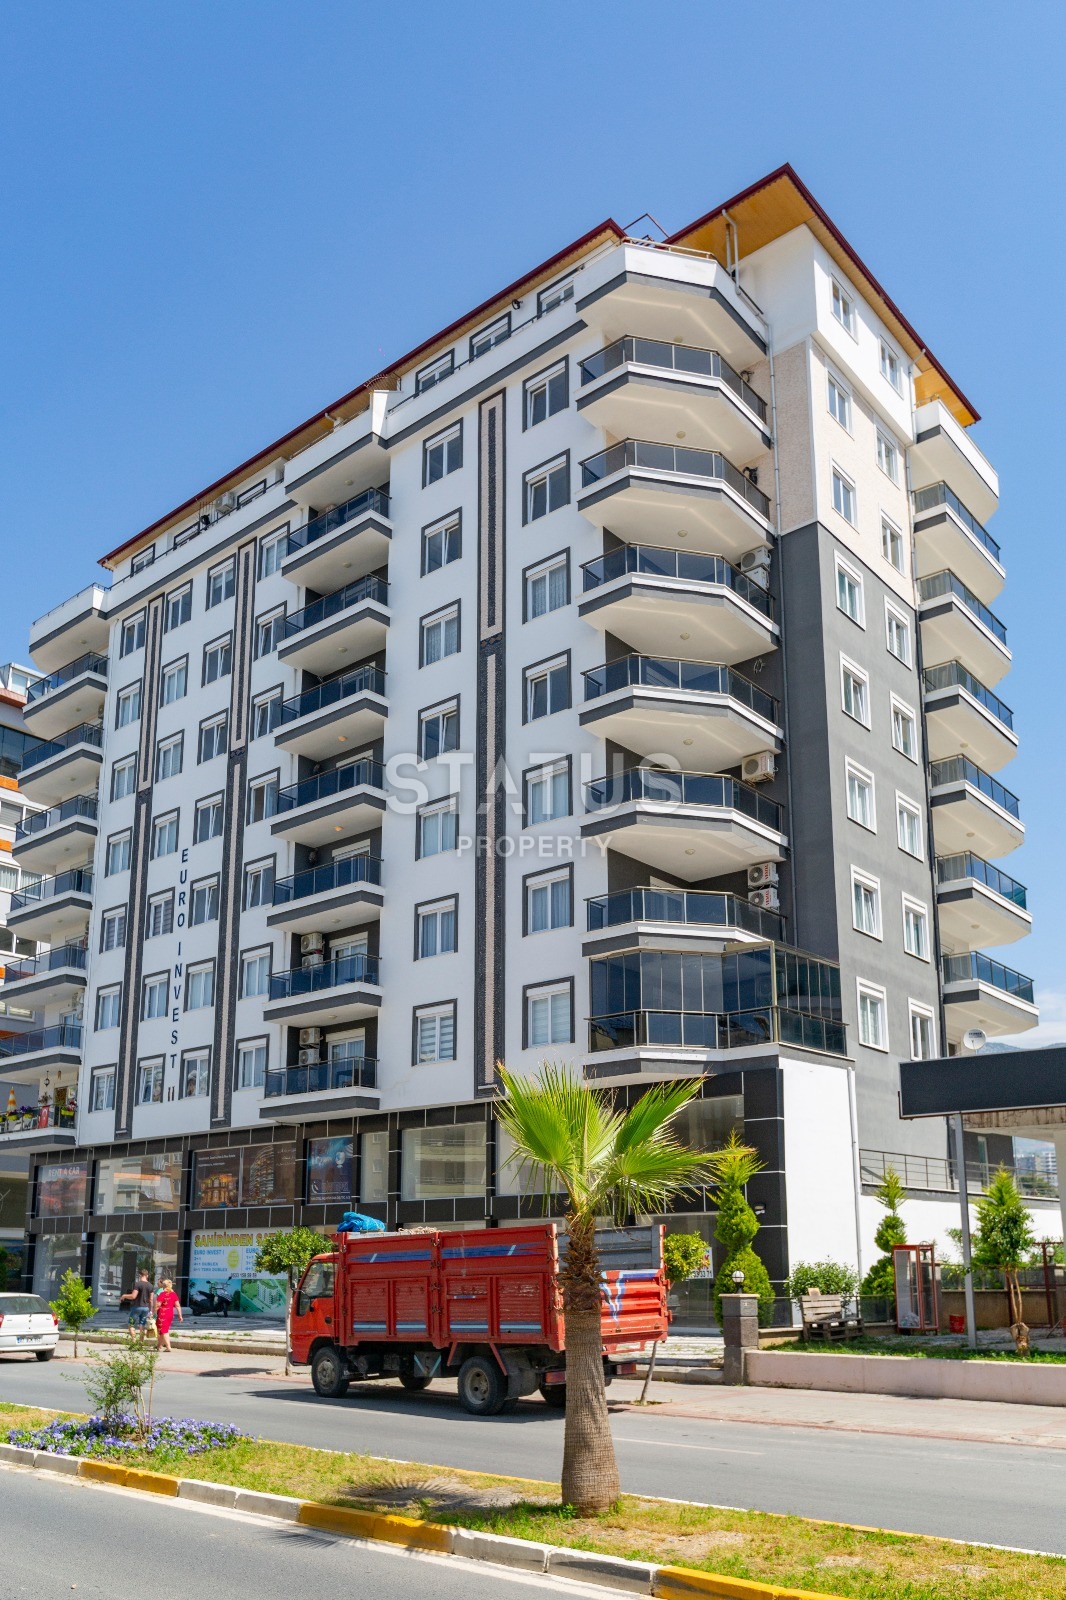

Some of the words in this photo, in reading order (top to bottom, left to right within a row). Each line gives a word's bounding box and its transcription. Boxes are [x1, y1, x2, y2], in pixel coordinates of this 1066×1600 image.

[177, 848, 189, 928] EURO
[170, 941, 182, 1069] INVEST
[68, 1166, 80, 1175] CAR
[194, 1232, 254, 1247] SAHİBİNDEN
